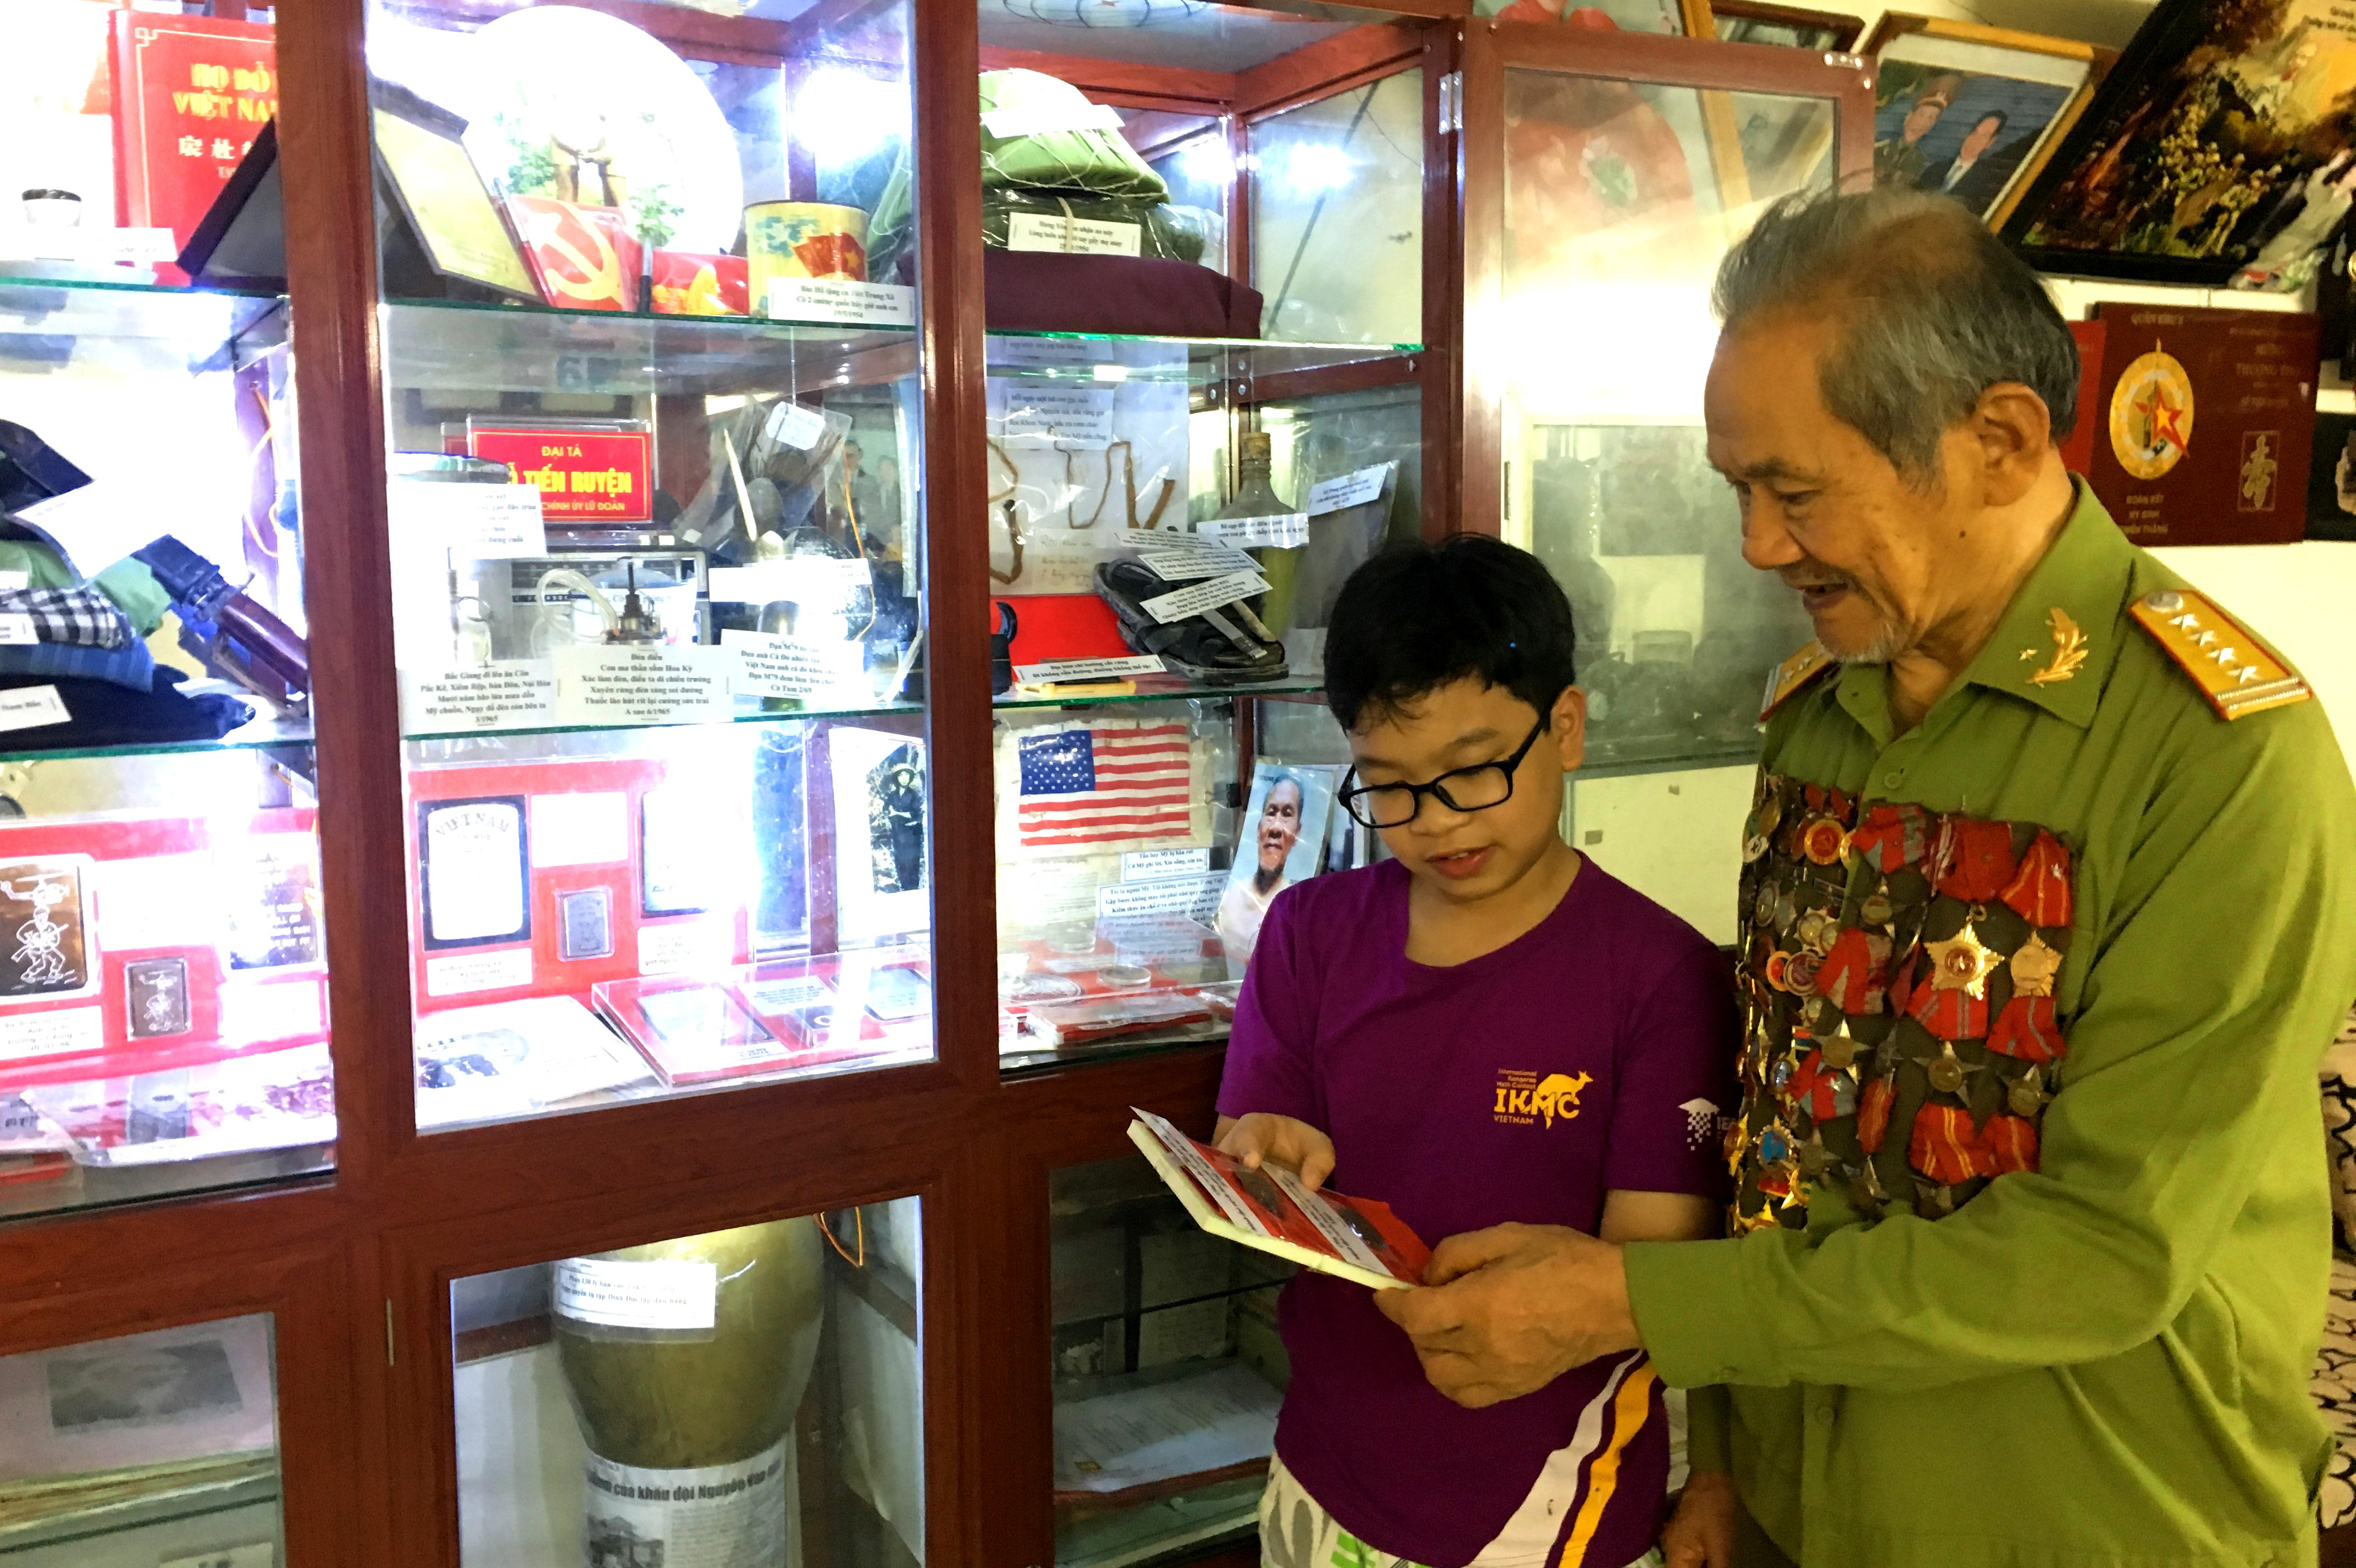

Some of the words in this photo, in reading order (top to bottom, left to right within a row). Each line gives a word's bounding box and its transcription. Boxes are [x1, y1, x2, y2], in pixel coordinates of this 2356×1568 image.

[541, 446, 564, 460] ĐẠI
[567, 443, 583, 457] TÁ
[523, 462, 566, 493] TIẾN
[571, 467, 632, 498] RUYỆN
[541, 500, 570, 511] CHÍNH
[597, 499, 625, 511] ĐOÀN
[1494, 1088, 1580, 1119] IKMC
[1494, 1115, 1533, 1124] VIETNAM
